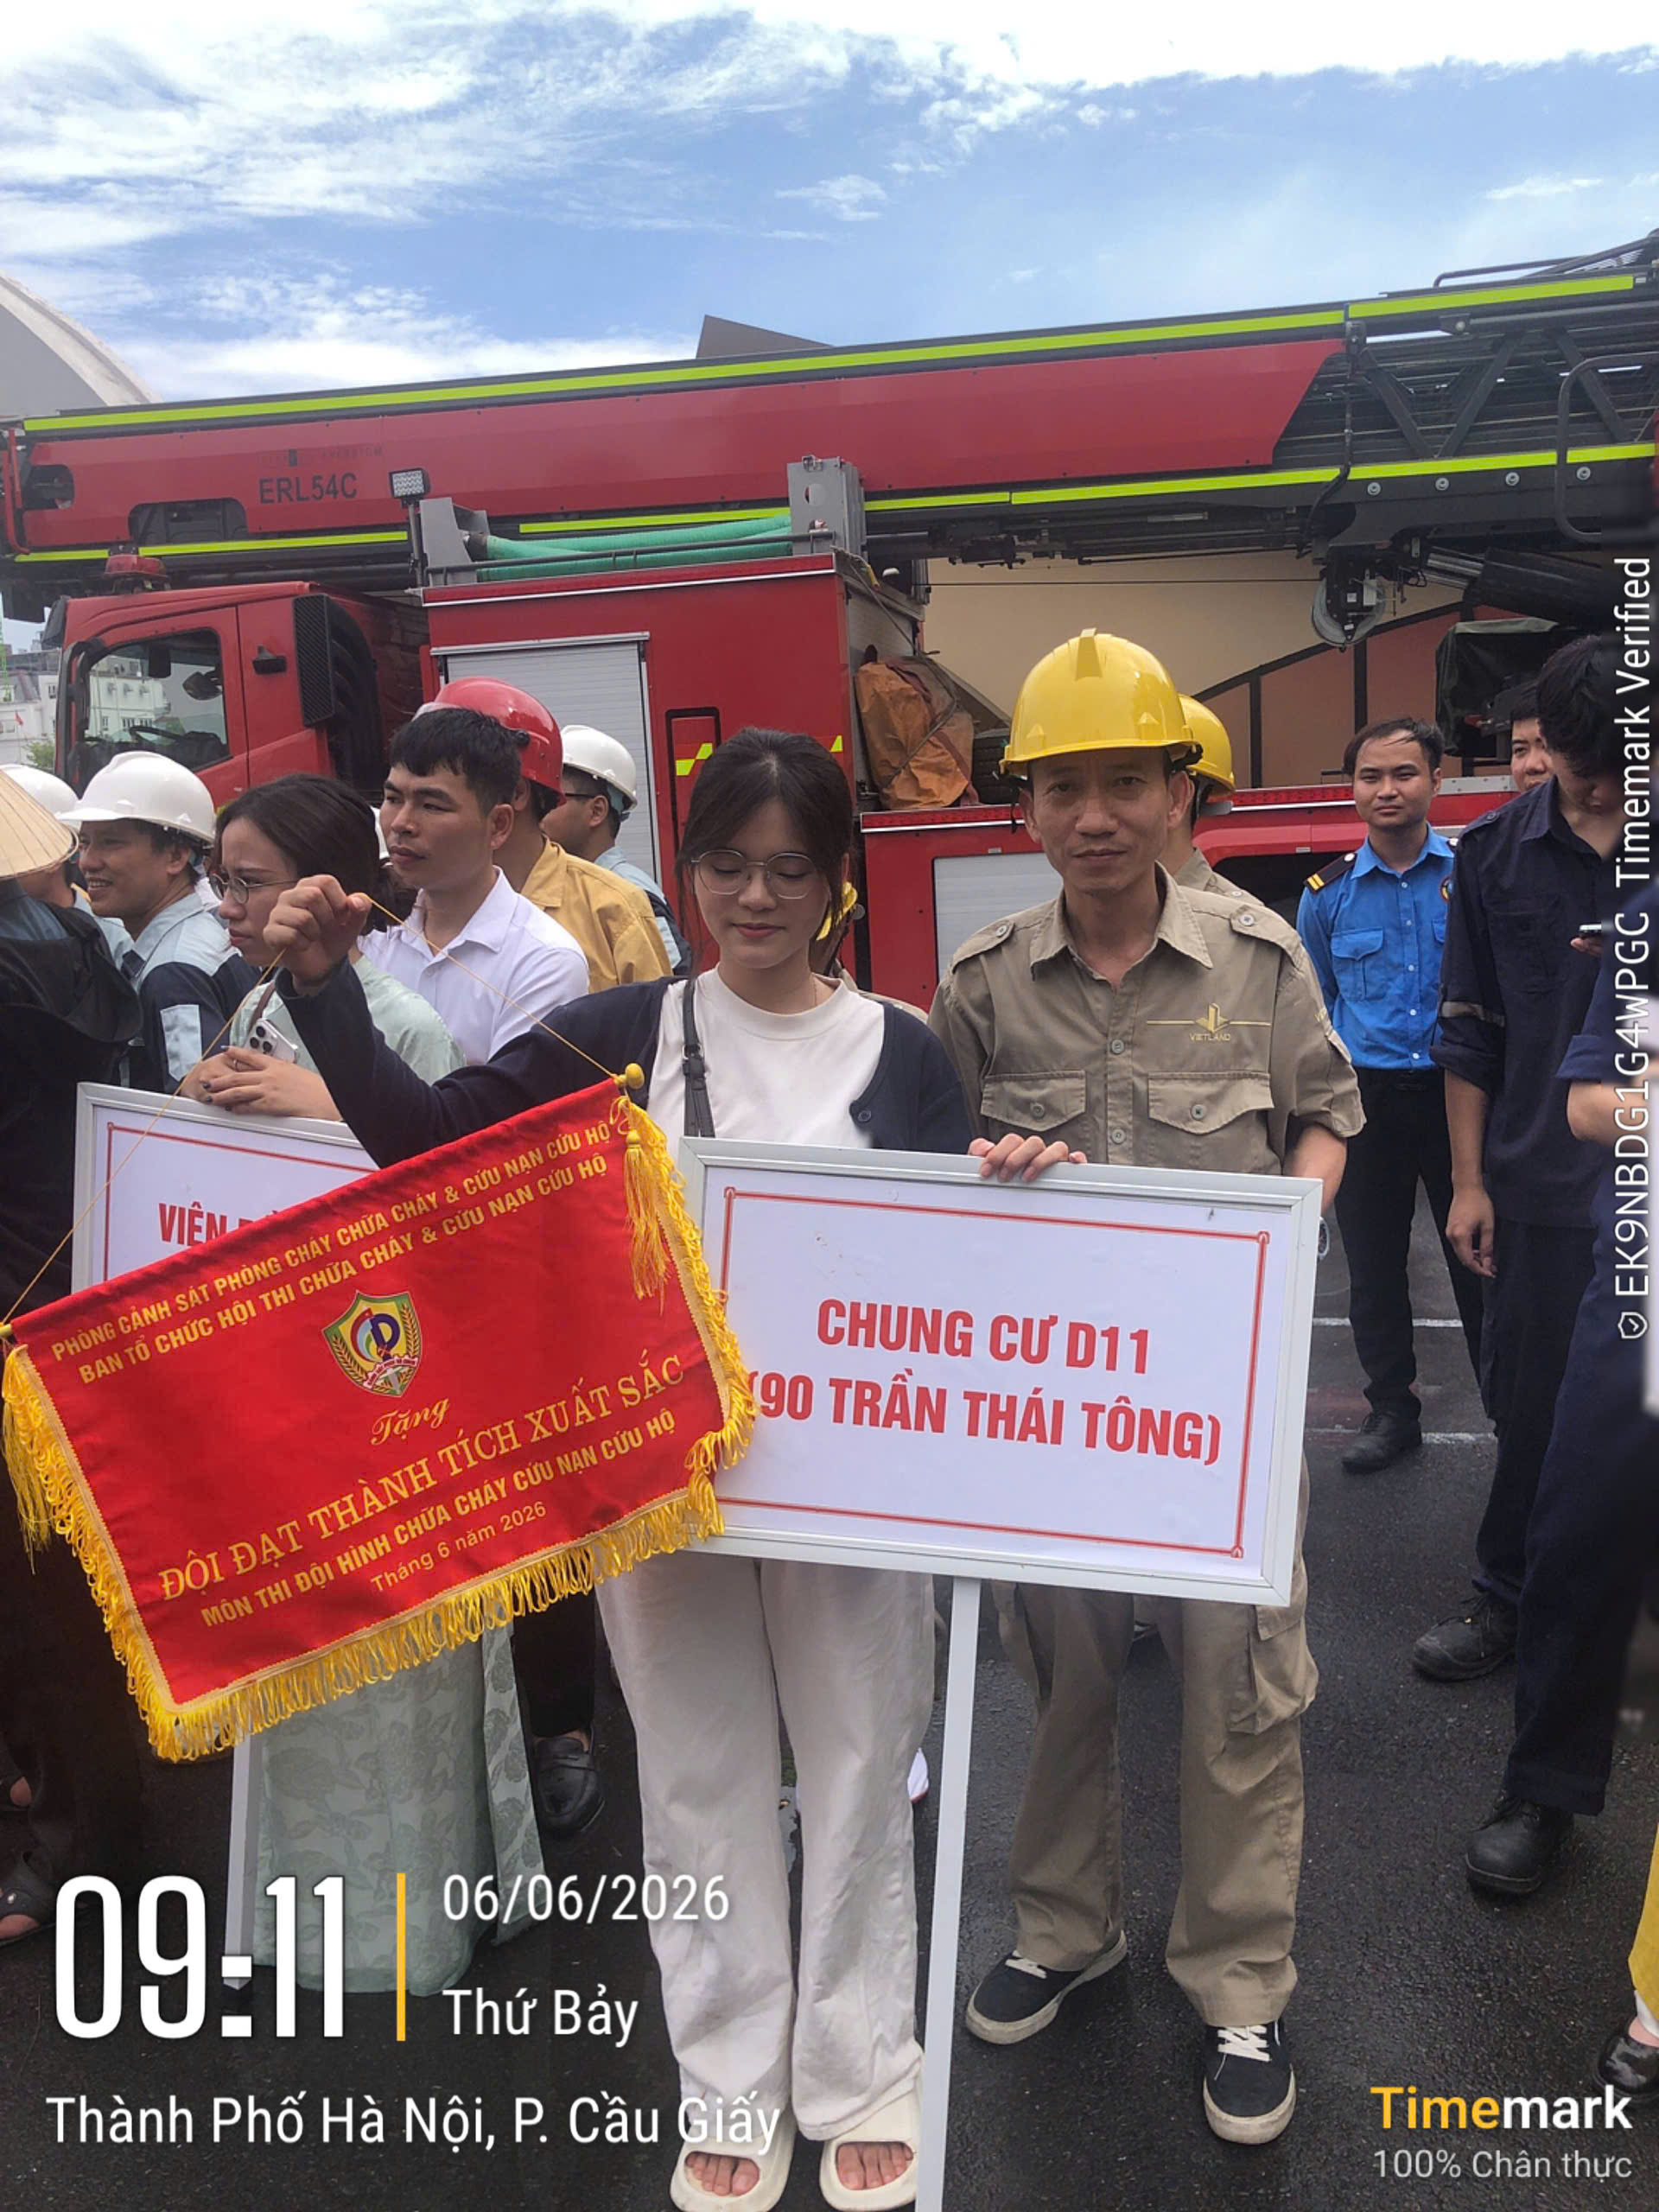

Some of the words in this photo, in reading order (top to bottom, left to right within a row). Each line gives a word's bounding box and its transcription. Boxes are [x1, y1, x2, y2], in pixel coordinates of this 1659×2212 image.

[259, 472, 357, 505] ERL54C
[52, 1322, 117, 1361] PHÒNG
[118, 1300, 172, 1335] CẢNH
[175, 1283, 210, 1312] SÁT
[214, 1256, 283, 1296] PHÒNG
[284, 1234, 332, 1268] CHÁY
[336, 1212, 389, 1246] CHỮA
[391, 1192, 439, 1223] CHÁY
[444, 1185, 460, 1204] &
[463, 1167, 501, 1196] CỨU
[504, 1147, 544, 1178] NẠN
[546, 1133, 582, 1160] CỨU
[585, 1121, 611, 1146] HỘ
[79, 1354, 124, 1383] BAN
[124, 1333, 151, 1365] TỔ
[155, 1317, 213, 1354] CHỨC
[218, 1299, 257, 1329] HỘI
[259, 1284, 296, 1311] THI
[299, 1259, 357, 1295] CHỮA
[359, 1232, 414, 1269] CHÁY
[422, 1226, 437, 1244] &
[442, 1206, 485, 1236] CỨU
[488, 1185, 535, 1217] NẠN
[537, 1167, 574, 1196] CỨU
[579, 1153, 607, 1179] HỘ
[817, 1299, 974, 1357] CHUNG
[988, 1314, 1058, 1365] CƯ
[1065, 1321, 1149, 1375] D11
[371, 1398, 449, 1445] Tặng
[829, 1367, 948, 1433] TRẦN
[963, 1386, 1065, 1446] THÁI
[1081, 1395, 1222, 1465] TÔNG)
[158, 1549, 225, 1600] ĐỘI
[228, 1521, 303, 1575] ĐẠT
[307, 1458, 437, 1540] THÀNH
[437, 1420, 522, 1477] TÍCH
[524, 1377, 613, 1443] XUẤT
[617, 1348, 684, 1408] SẮC
[200, 1596, 253, 1627] MÔN
[255, 1579, 292, 1609] THI
[295, 1561, 335, 1590] ĐỘI
[336, 1534, 391, 1574] HÌNH
[394, 1504, 452, 1545] CHỮA
[454, 1477, 508, 1516] CHÁY
[512, 1461, 554, 1492] CỨU
[556, 1445, 598, 1475] NẠN
[601, 1427, 644, 1460] CỨU
[646, 1408, 676, 1439] HỘ
[371, 1552, 435, 1591] Tháng
[437, 1541, 450, 1558] 6
[455, 1527, 496, 1551] năm
[500, 1501, 546, 1532] 2026
